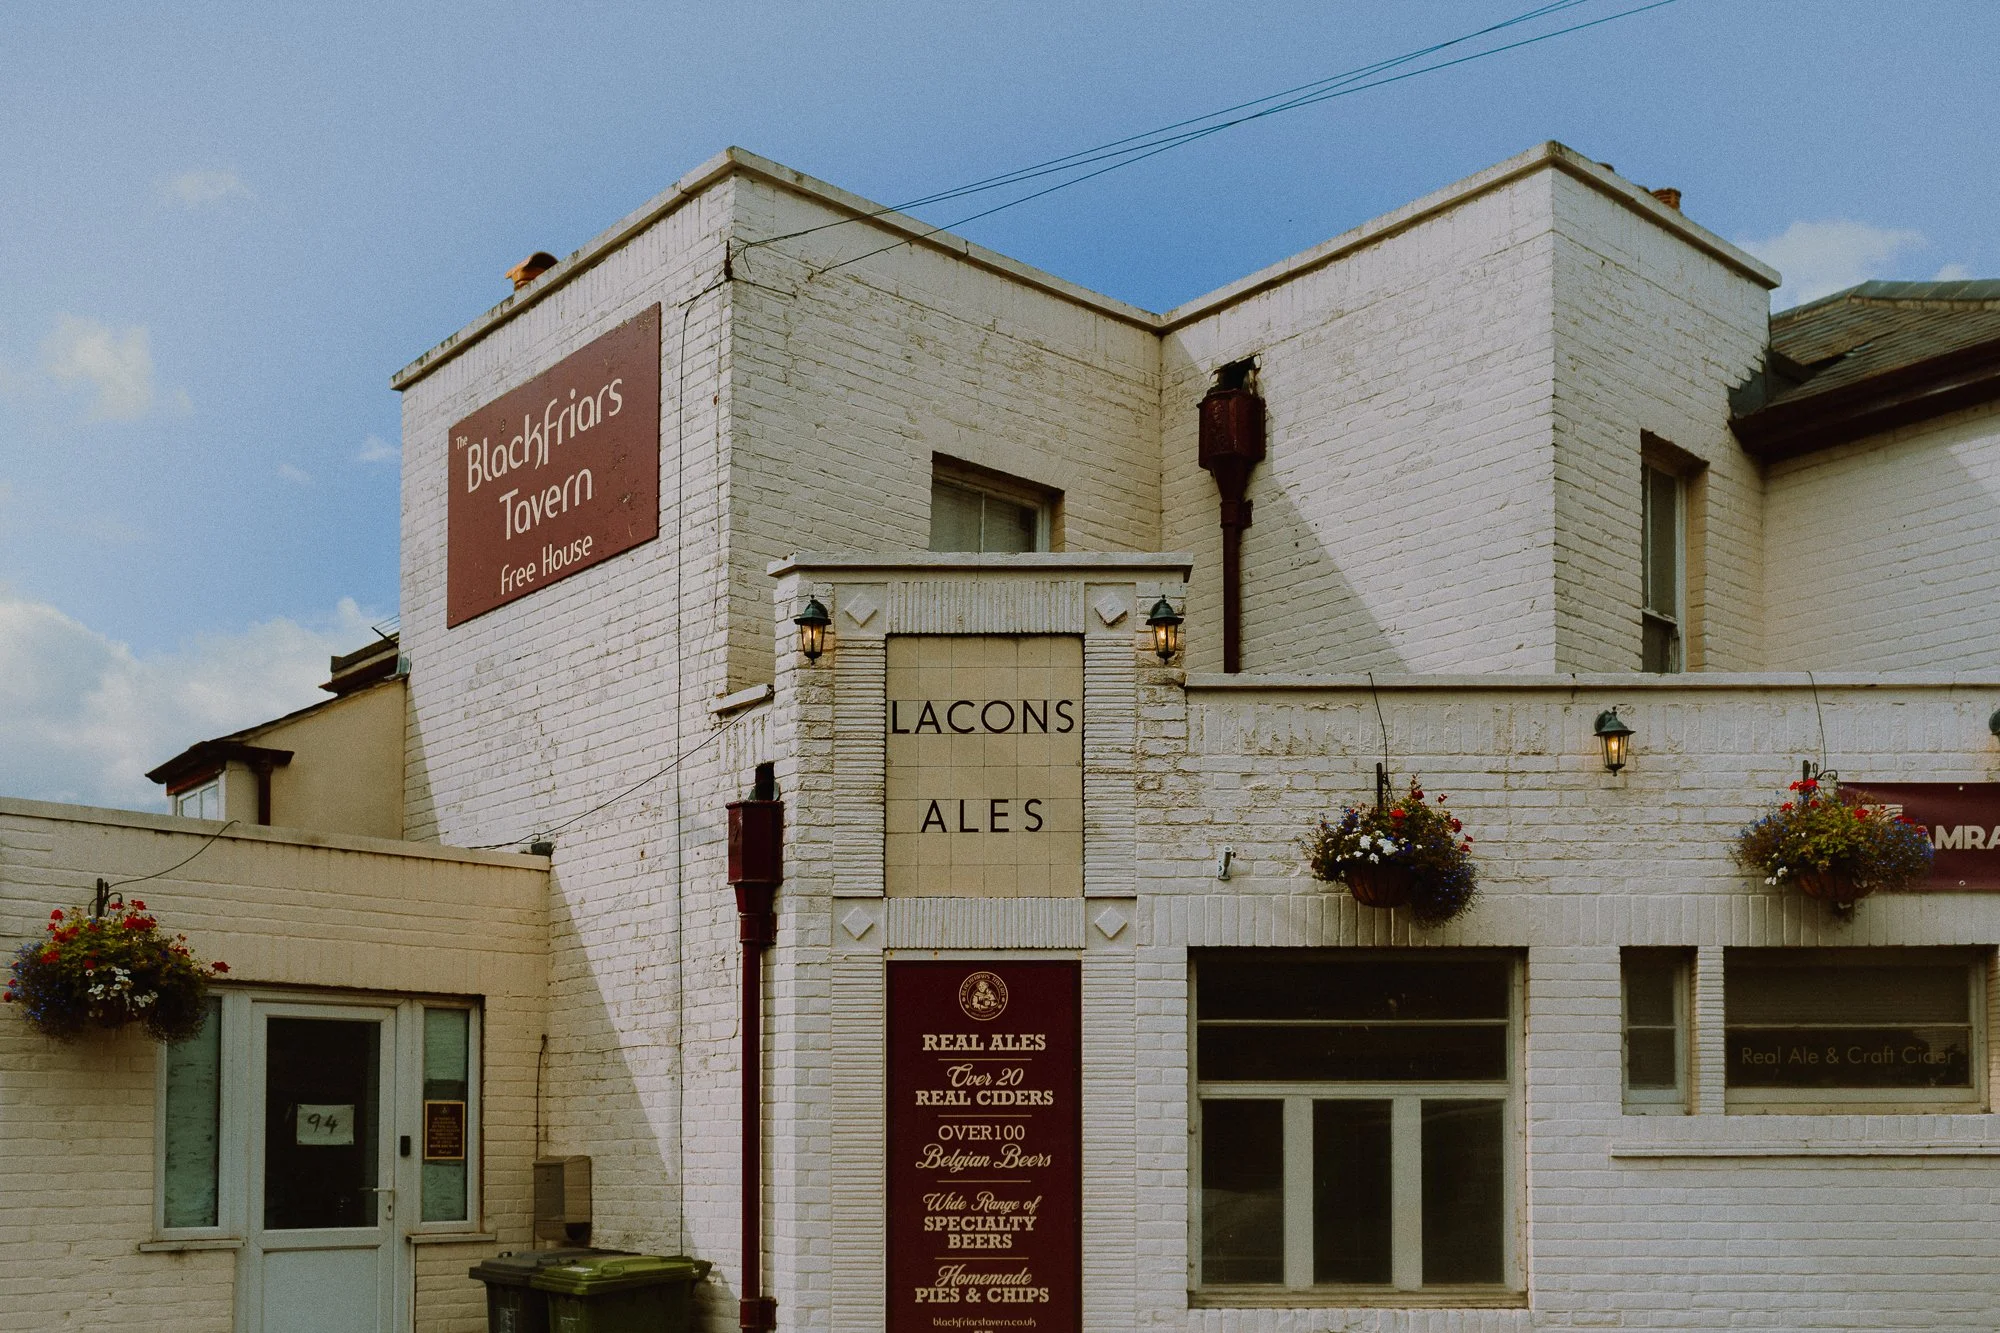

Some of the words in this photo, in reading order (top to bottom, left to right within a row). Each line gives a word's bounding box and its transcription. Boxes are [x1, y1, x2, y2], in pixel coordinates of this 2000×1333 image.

[456, 435, 468, 450] The
[467, 378, 623, 493] Blackfriars
[499, 468, 593, 540] Tavern
[501, 563, 536, 595] Free
[542, 535, 593, 577] House
[891, 699, 1075, 735] LACONS
[920, 799, 1043, 833] ALES
[922, 1034, 985, 1051] REAL
[989, 1034, 1047, 1051] ALES
[1741, 1047, 1781, 1064] Real
[1788, 1047, 1819, 1064] Ale
[1826, 1047, 1840, 1064] &
[1847, 1047, 1894, 1064] Craft
[1902, 1047, 1954, 1064] Cider
[946, 1063, 993, 1088] Over
[995, 1068, 1024, 1087] 20
[915, 1090, 971, 1106] REAL
[976, 1090, 1054, 1106] CIDERS
[307, 1113, 339, 1134] 94
[915, 1143, 991, 1173] Belgian
[993, 1143, 1052, 1169] Beers
[922, 1191, 967, 1212] Wide
[971, 1191, 1020, 1214] Range
[1023, 1195, 1043, 1215] of
[924, 1216, 1038, 1232] SPECIALTY
[947, 1233, 1013, 1249] BEERS
[935, 1264, 1032, 1287] Homemade
[914, 1287, 960, 1303] PIES
[965, 1287, 981, 1303] &
[986, 1287, 1050, 1303] CHIPS
[933, 1317, 1037, 1328] blackfriarstavern.co.uk
